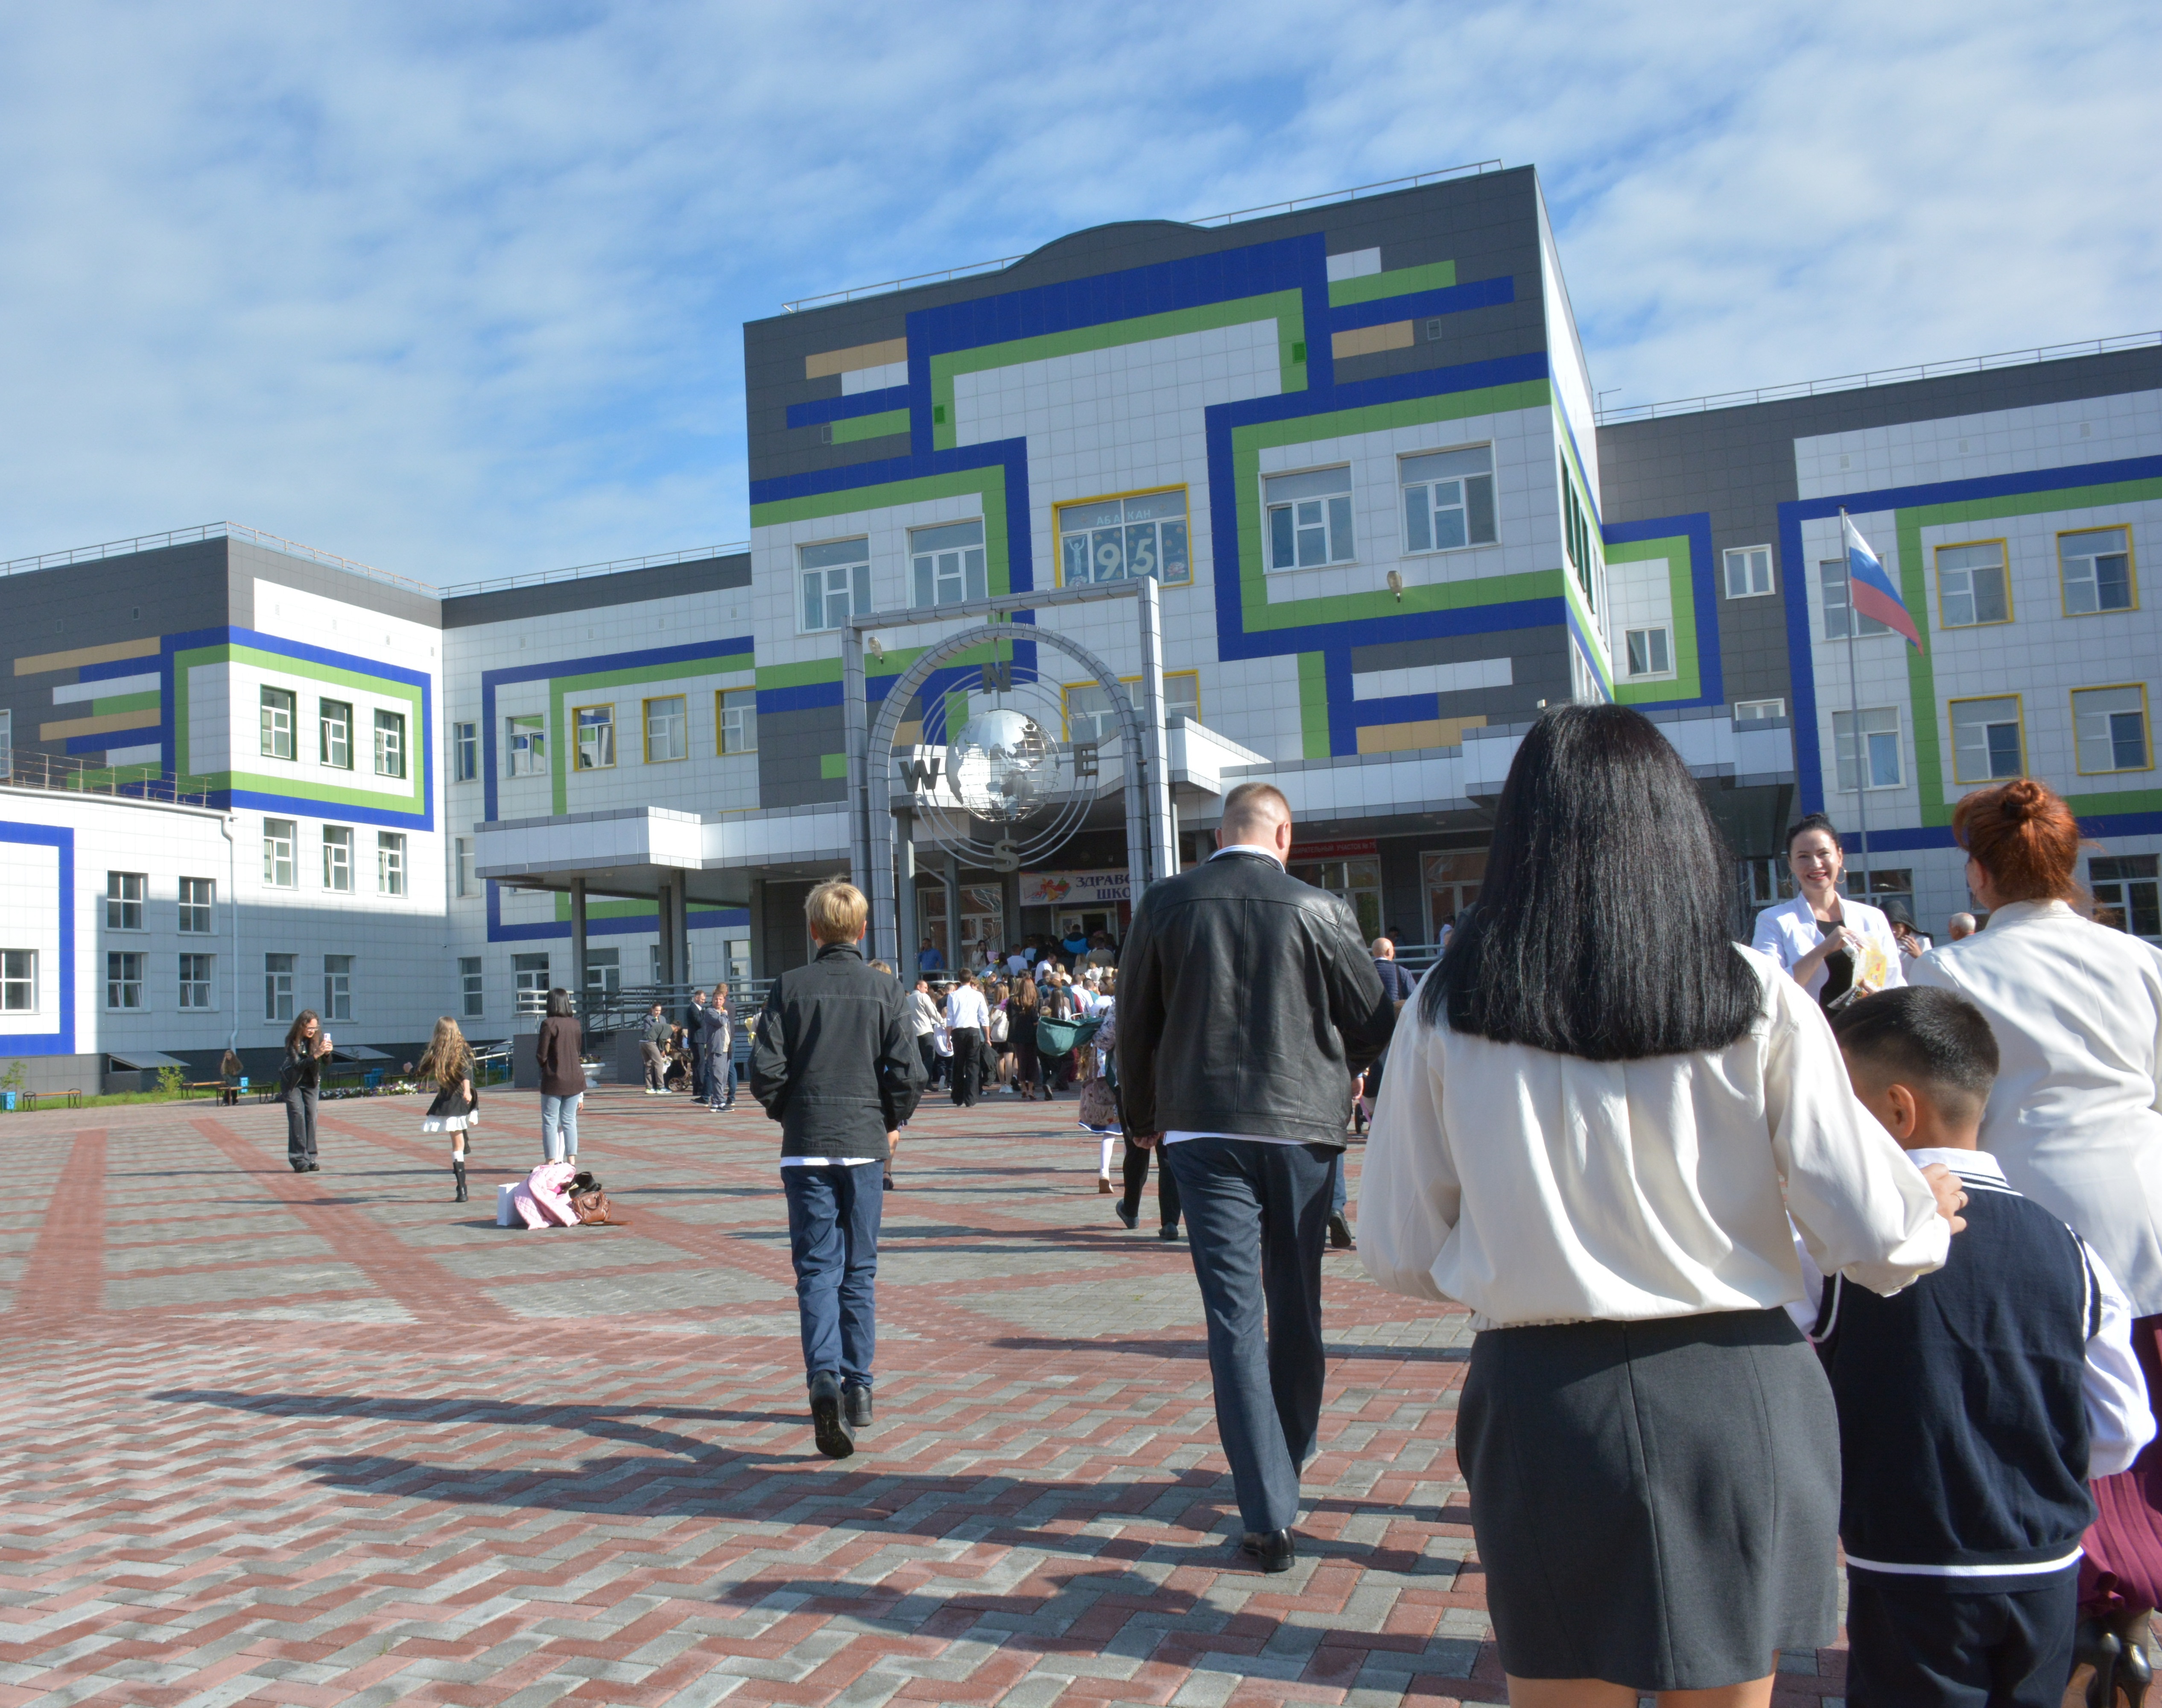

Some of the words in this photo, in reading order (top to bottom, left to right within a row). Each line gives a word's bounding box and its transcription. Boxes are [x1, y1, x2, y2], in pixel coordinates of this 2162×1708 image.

[1096, 509, 1150, 526] АБАКАН
[1097, 538, 1154, 579] 95
[982, 661, 1011, 694] N
[899, 757, 940, 792] W
[1074, 743, 1098, 776] E
[993, 839, 1020, 872] S
[1290, 844, 1334, 854] ЗБИРАТЕЛЬНЫЙ
[1097, 887, 1131, 899] ШКО
